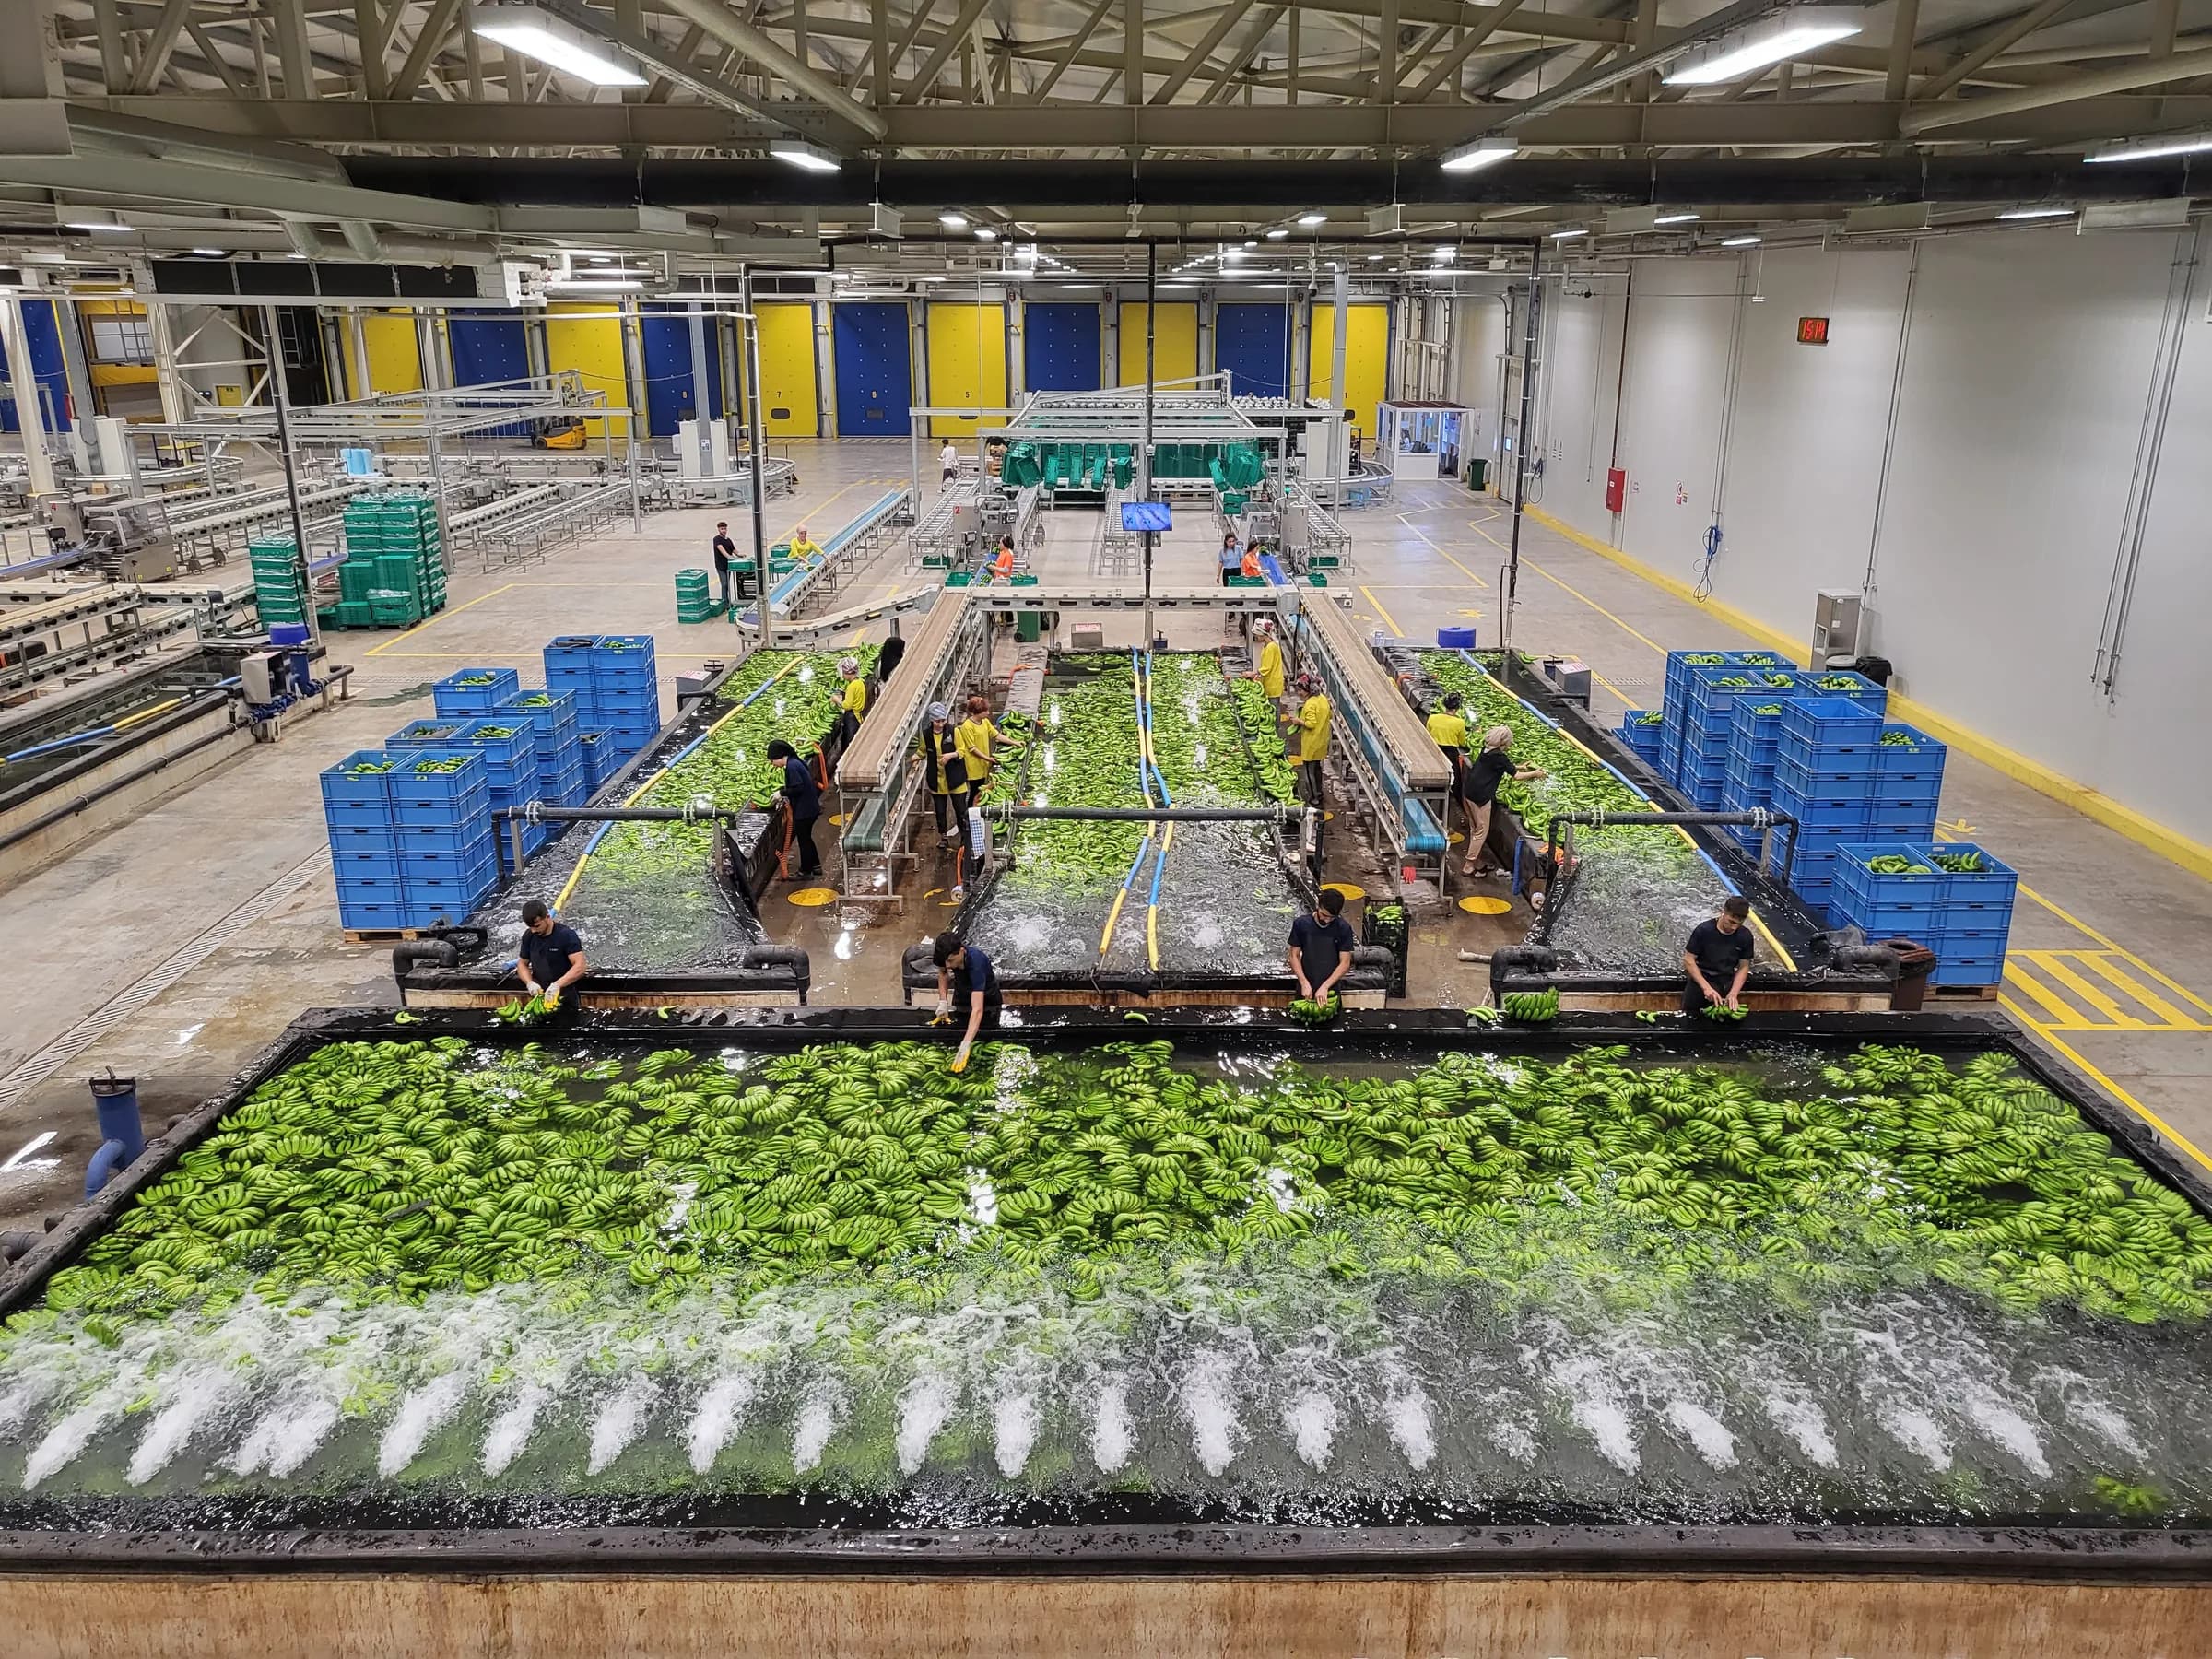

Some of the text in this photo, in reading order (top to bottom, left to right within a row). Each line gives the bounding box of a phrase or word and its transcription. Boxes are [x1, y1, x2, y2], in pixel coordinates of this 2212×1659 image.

[776, 391, 782, 399] 7
[965, 391, 971, 399] 5
[955, 506, 960, 514] 2
